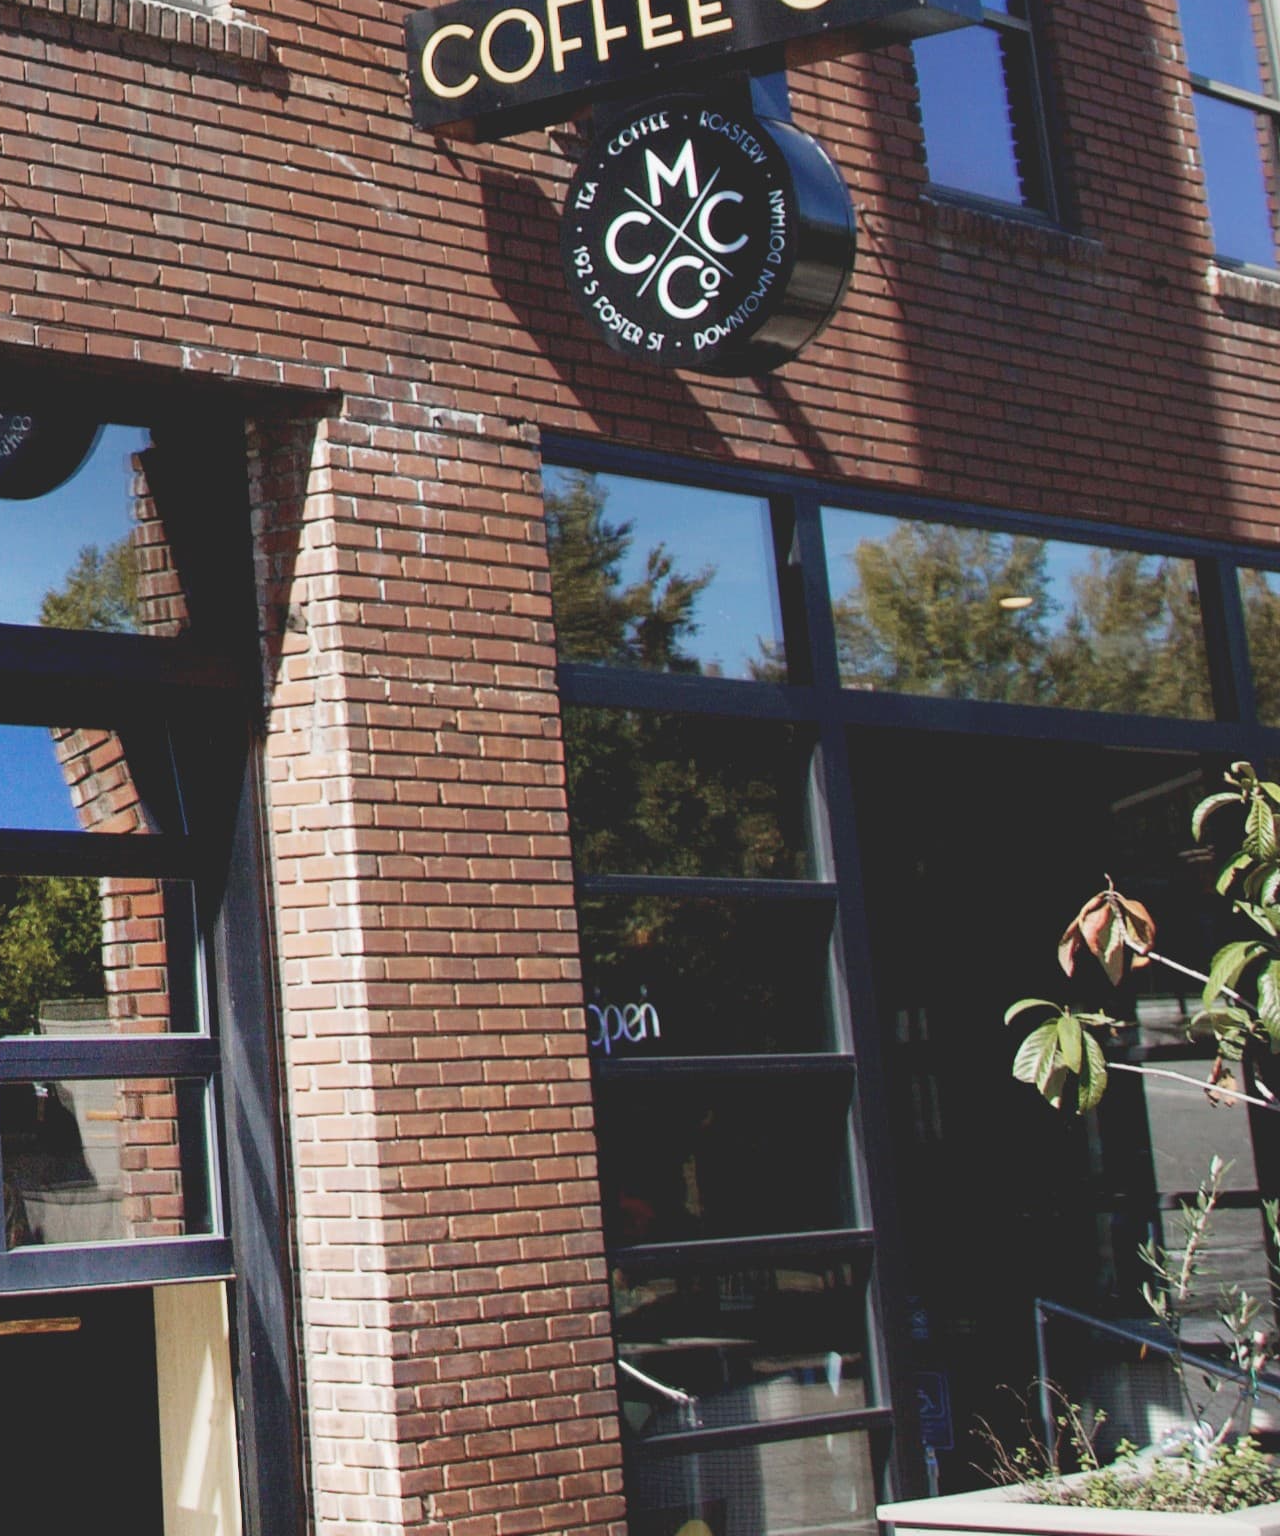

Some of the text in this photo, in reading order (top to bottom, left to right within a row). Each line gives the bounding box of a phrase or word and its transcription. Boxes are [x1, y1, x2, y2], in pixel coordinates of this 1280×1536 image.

[575, 110, 768, 210] TEA COFFEE ROASTERY
[645, 138, 698, 206] M
[573, 245, 665, 351] 192 S FOSTER ST
[693, 189, 786, 350] DOWNTOWN DOTHAN
